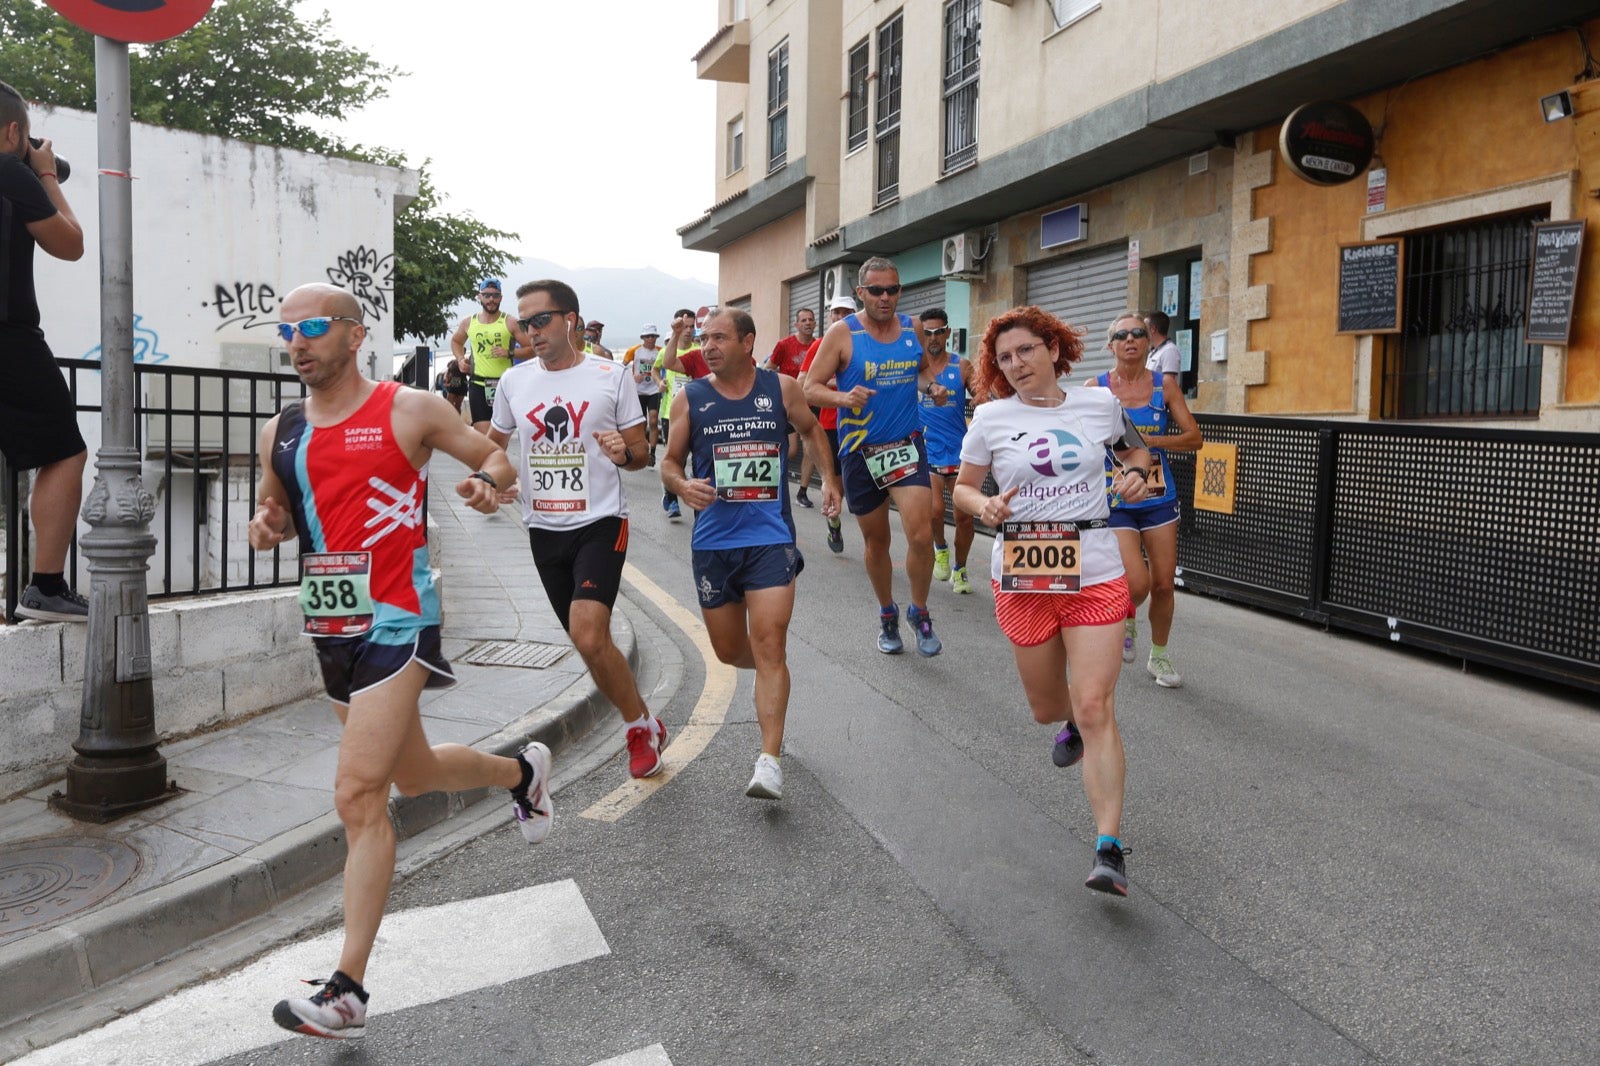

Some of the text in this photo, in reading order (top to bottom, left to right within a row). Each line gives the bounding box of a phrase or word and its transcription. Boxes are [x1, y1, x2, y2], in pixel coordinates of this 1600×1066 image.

[880, 359, 918, 371] olimpo
[344, 427, 383, 436] SAPIENS
[703, 423, 735, 436] PAZITO
[744, 421, 777, 430] PAZITO
[729, 431, 751, 439] Motril
[345, 434, 383, 444] HUMAN
[875, 448, 911, 472] 725
[727, 460, 772, 482] 742
[532, 467, 584, 492] 3078
[535, 500, 575, 511] Cruzcampo
[1012, 545, 1077, 569] 2008
[307, 579, 358, 610] 358
